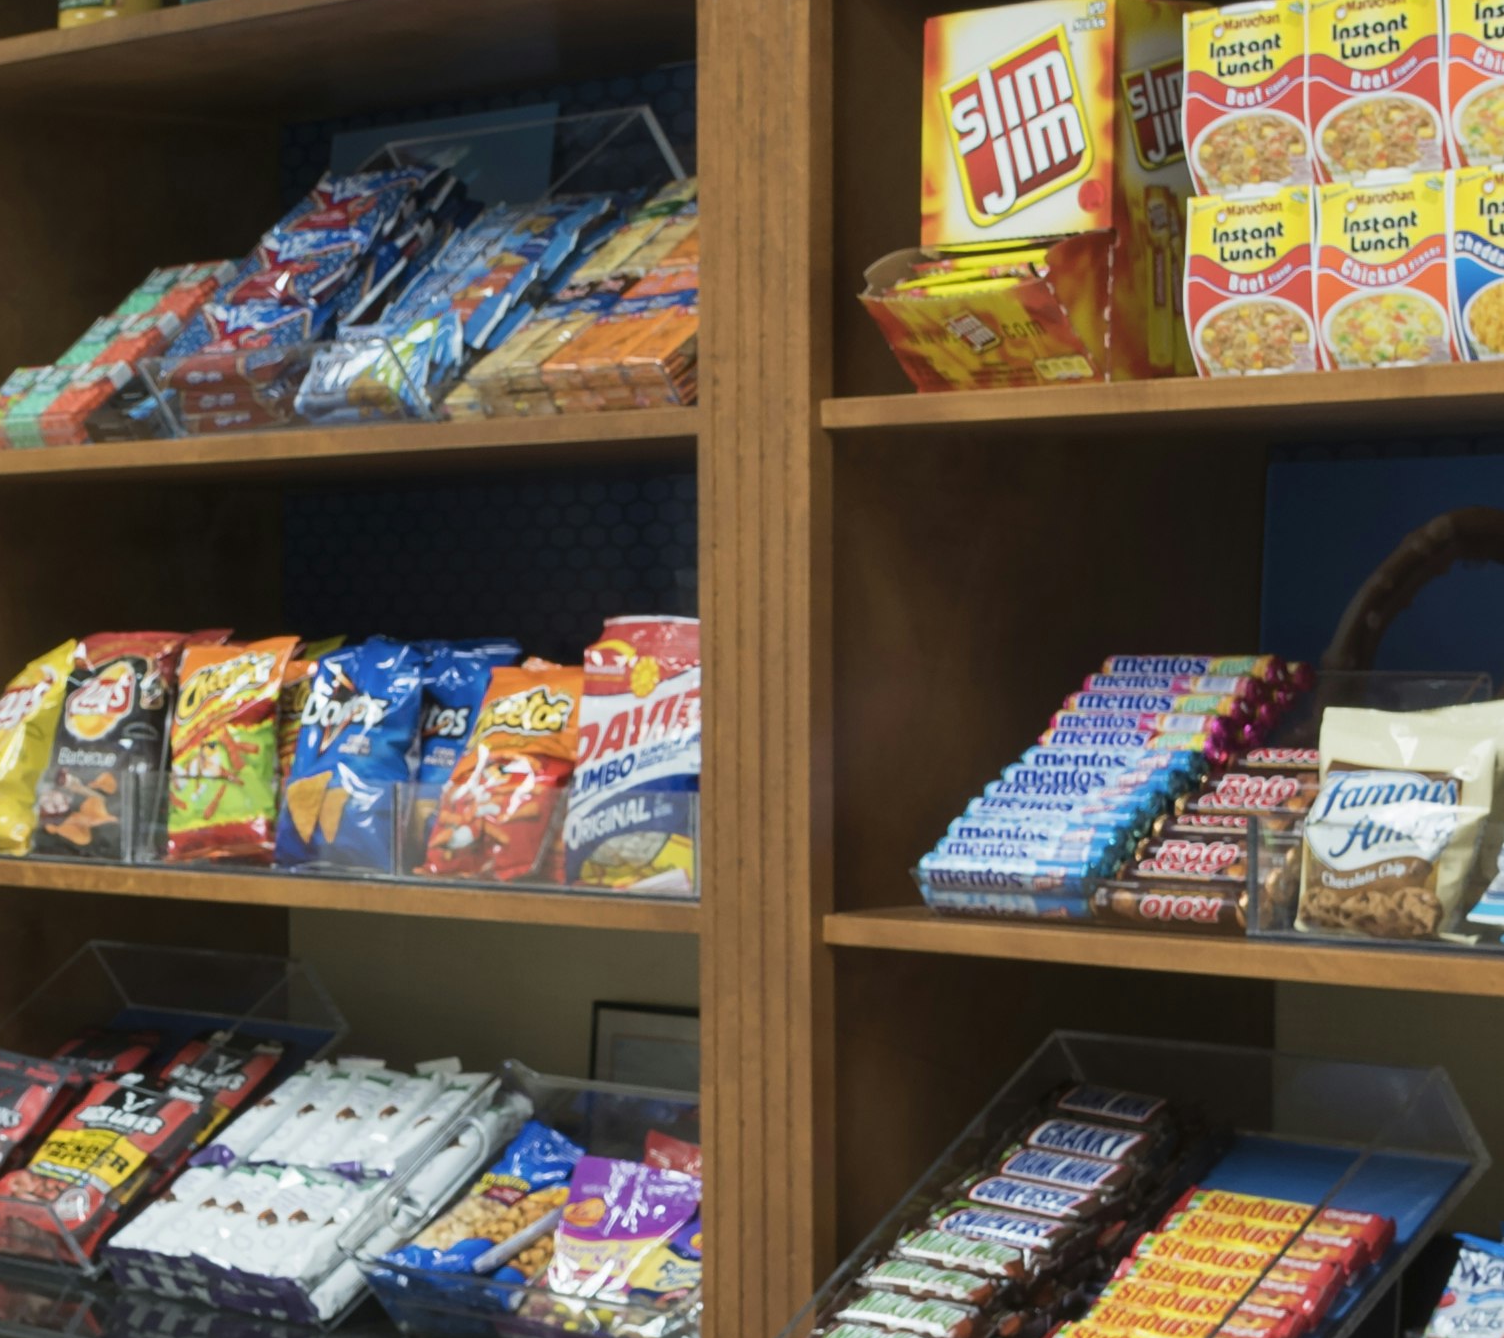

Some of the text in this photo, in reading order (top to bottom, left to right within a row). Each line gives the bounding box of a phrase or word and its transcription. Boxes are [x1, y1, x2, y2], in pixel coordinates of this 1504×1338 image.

[1223, 13, 1280, 30] Maruchan
[1332, 13, 1408, 41] Instant
[1209, 33, 1282, 59] Instant
[1341, 35, 1401, 60] Lunch
[1217, 55, 1274, 77] Lunch
[1354, 189, 1416, 208] Maruchan
[1226, 201, 1283, 218] Maruchan
[1343, 210, 1418, 234] Instant
[1212, 221, 1285, 245] Instant
[1350, 233, 1409, 254] Lunch
[1220, 244, 1277, 264] Lunch
[1112, 655, 1209, 676] mentos
[1091, 673, 1171, 690] mentos
[1076, 692, 1174, 712] mentos
[1058, 713, 1138, 730] mentos
[1050, 730, 1150, 747] mentos
[1014, 768, 1107, 788] mentos
